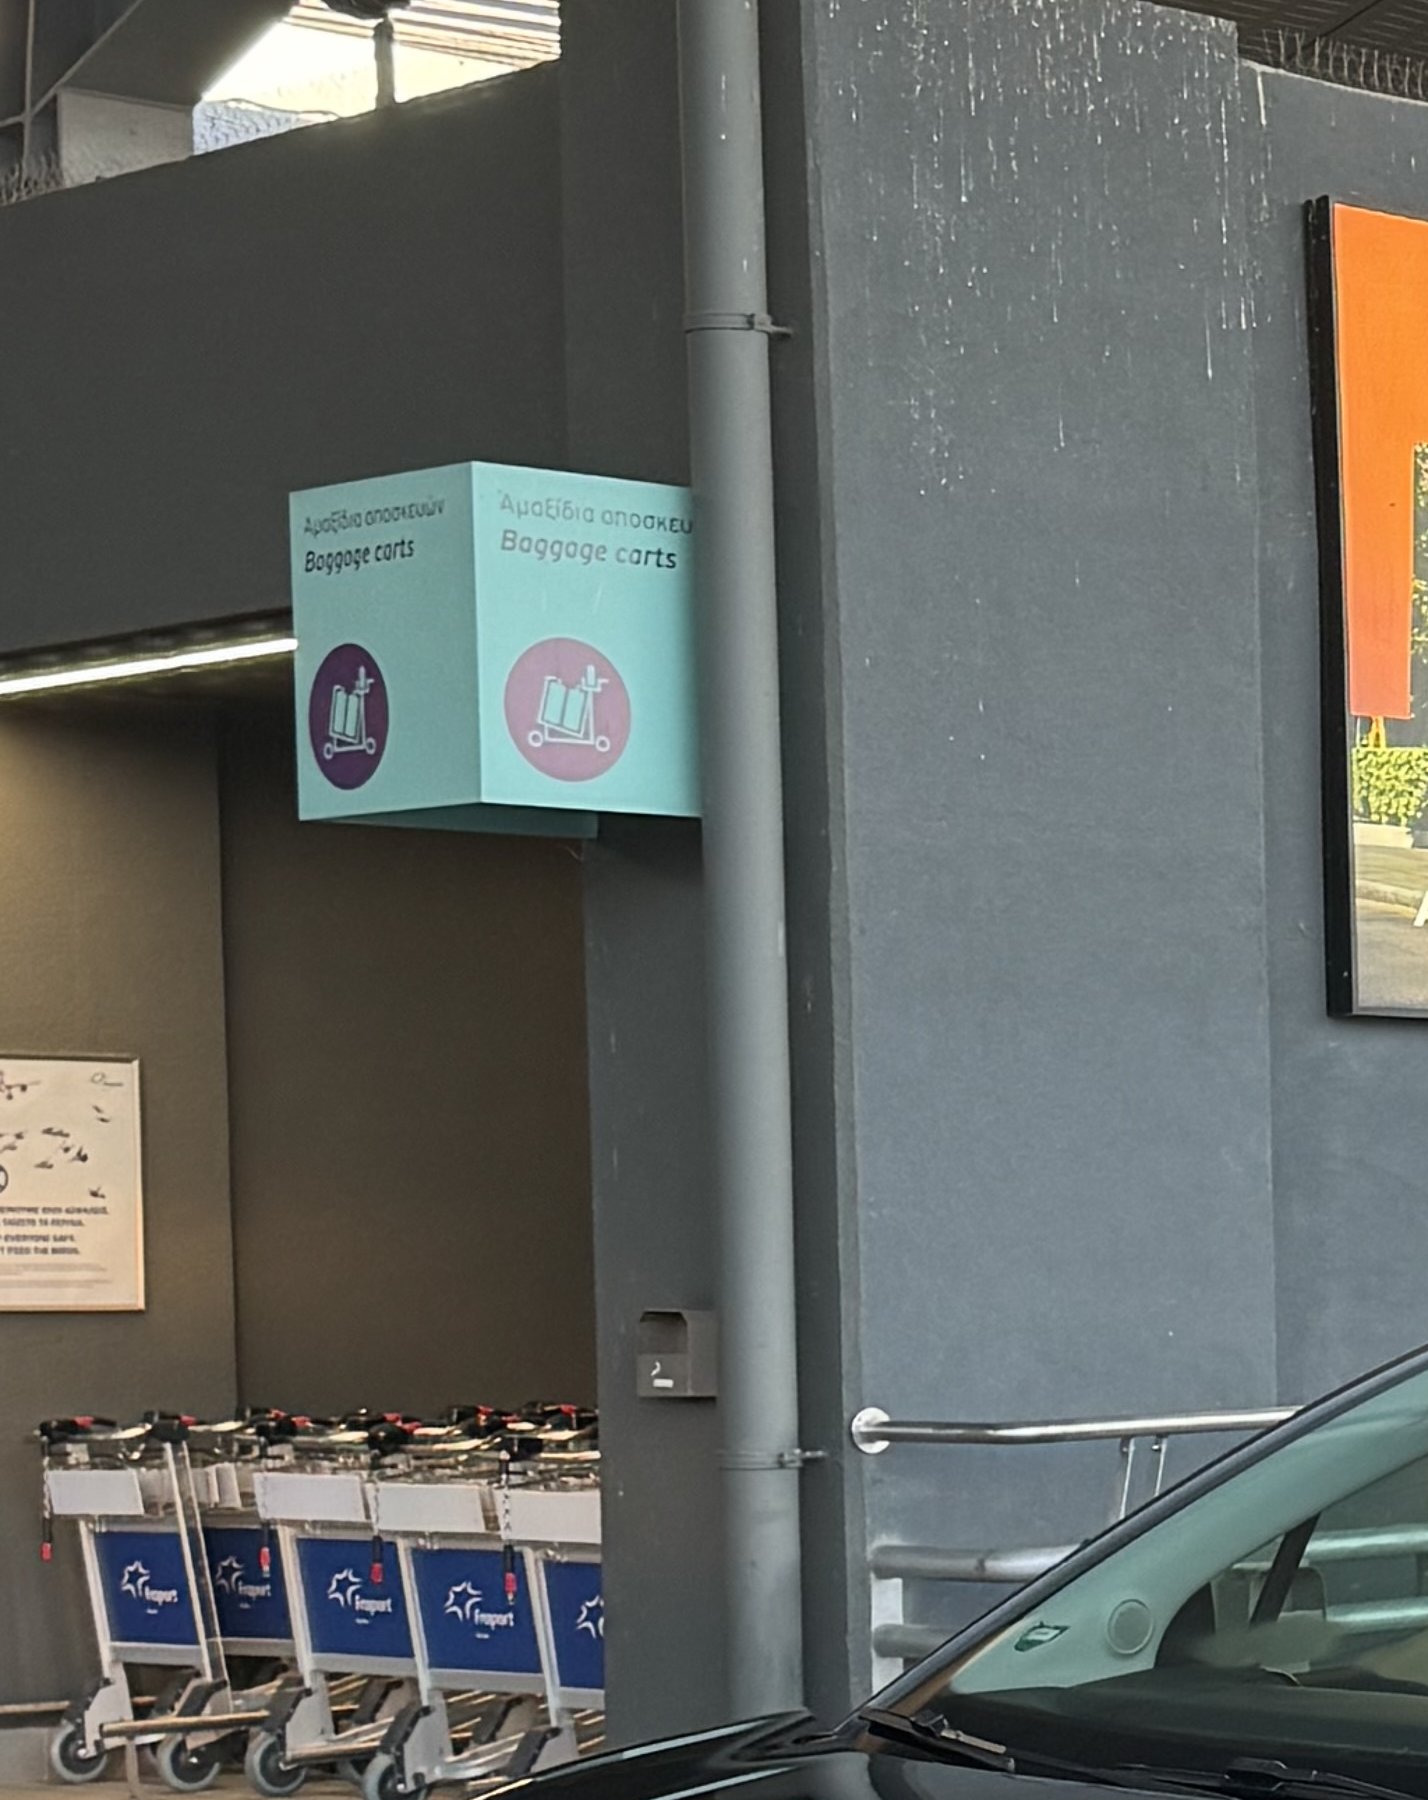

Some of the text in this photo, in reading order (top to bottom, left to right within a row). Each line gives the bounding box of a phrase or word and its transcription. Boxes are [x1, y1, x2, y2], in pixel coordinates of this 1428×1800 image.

[601, 508, 693, 535] αποσκευ
[304, 538, 415, 576] Baggage carts
[501, 528, 678, 569] Baggage carts
